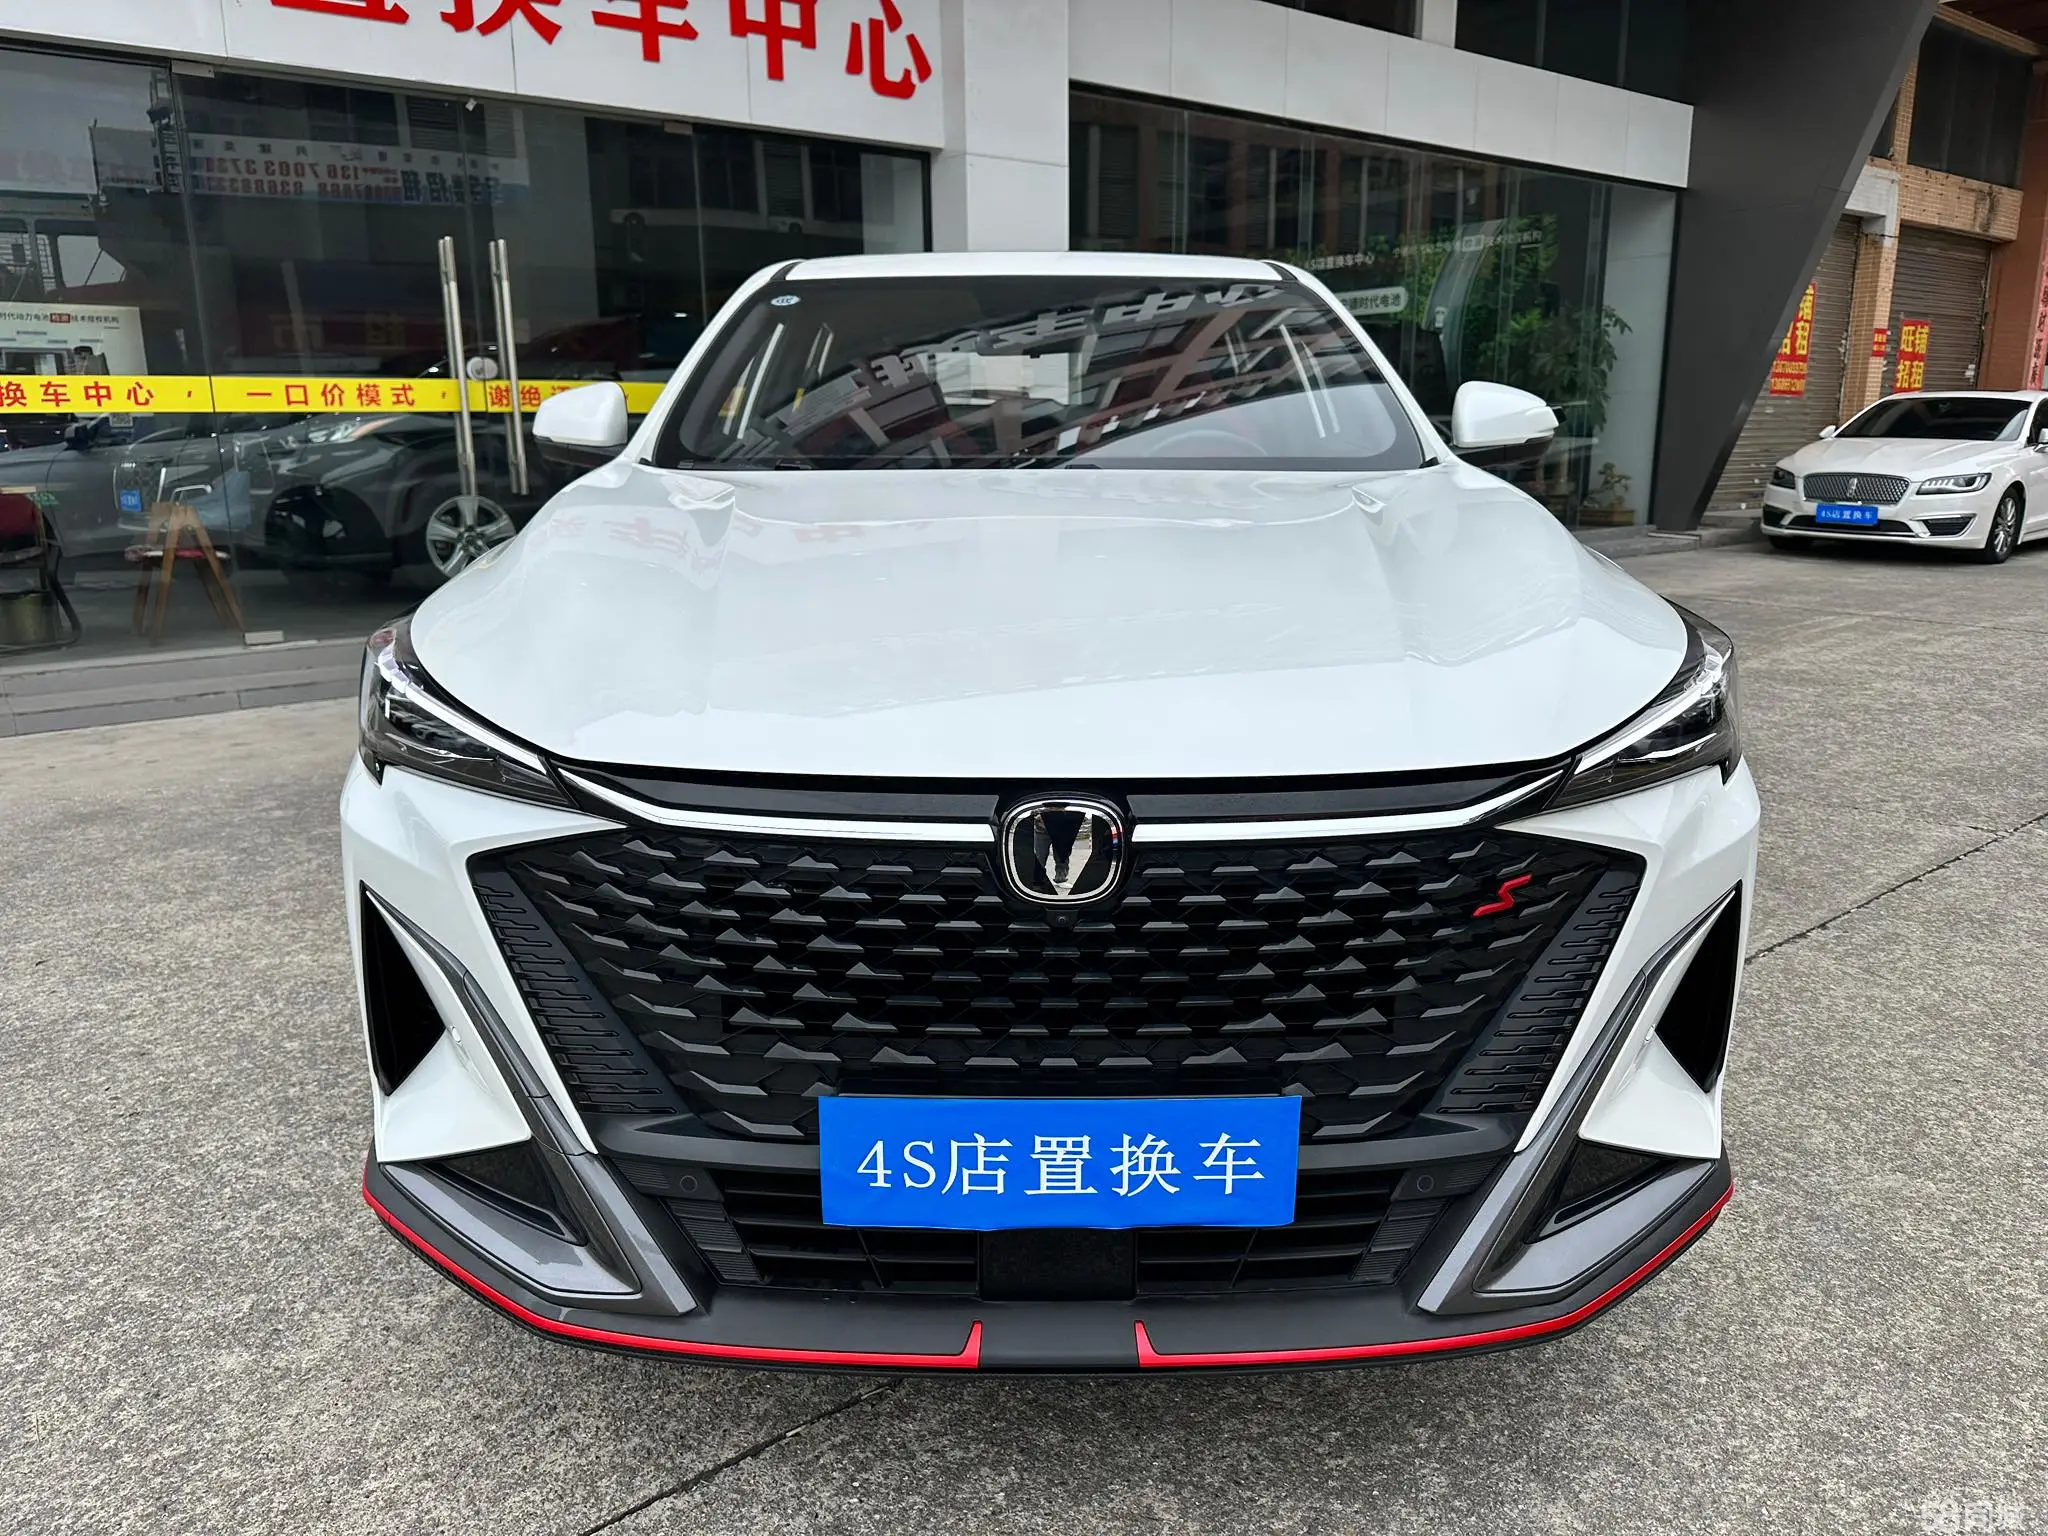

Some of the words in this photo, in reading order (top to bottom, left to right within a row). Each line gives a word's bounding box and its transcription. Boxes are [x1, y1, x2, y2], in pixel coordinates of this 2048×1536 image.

[1901, 325, 1928, 353] 旺铺
[1896, 360, 1925, 388] 招租
[856, 1132, 1265, 1197] 4S店置换车
